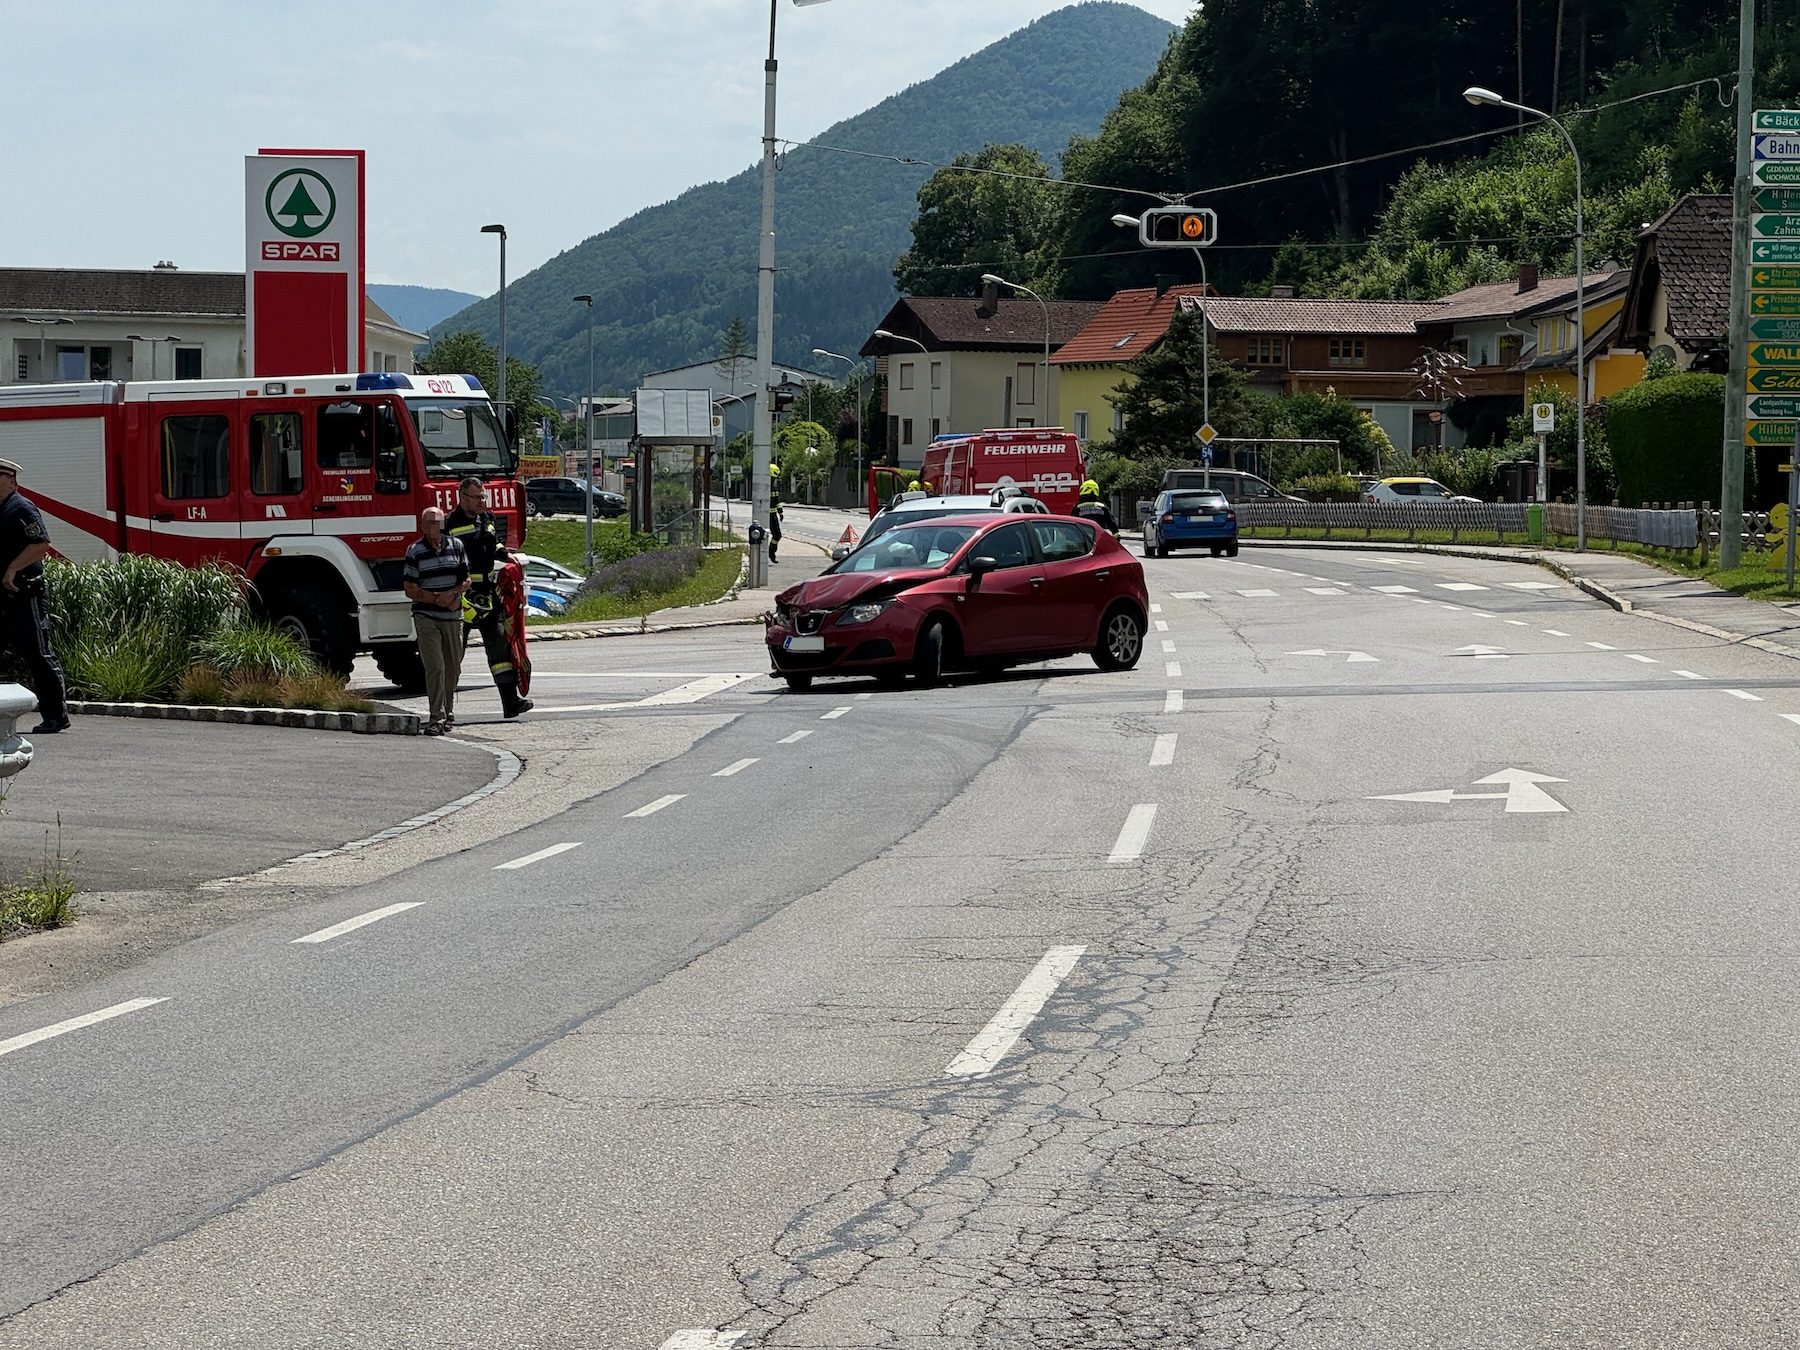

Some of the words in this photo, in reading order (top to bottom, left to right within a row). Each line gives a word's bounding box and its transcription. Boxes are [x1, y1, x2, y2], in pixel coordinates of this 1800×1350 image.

[265, 244, 337, 259] SPAR
[439, 380, 456, 393] 122
[984, 444, 1066, 456] FEUERWEHR
[1202, 447, 1213, 458] 54
[1032, 472, 1072, 493] 122
[187, 506, 207, 519] LF-A
